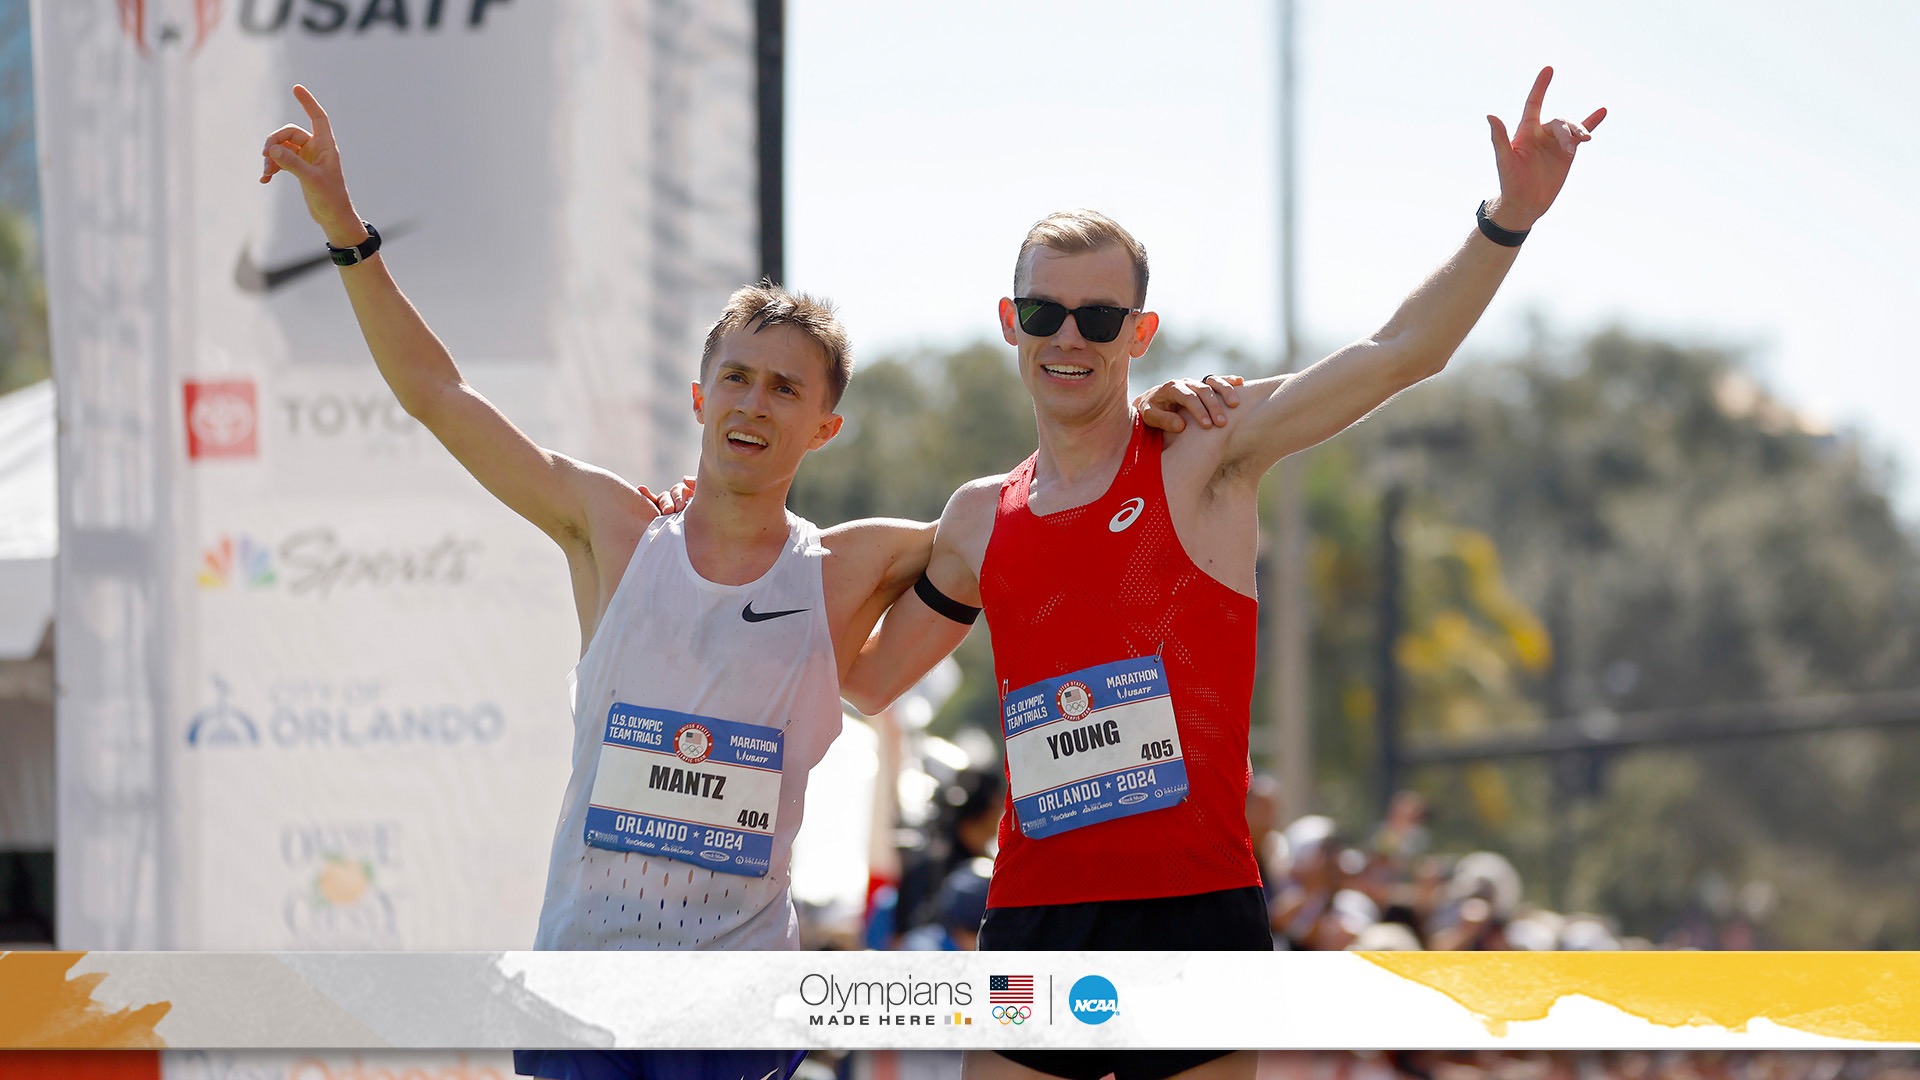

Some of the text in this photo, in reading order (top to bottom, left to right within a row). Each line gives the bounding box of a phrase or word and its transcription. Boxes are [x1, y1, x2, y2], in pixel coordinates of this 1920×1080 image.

[1106, 668, 1158, 689] MARATHON
[1127, 686, 1152, 697] USATF
[1006, 693, 1045, 717] U.S. OLYMPIC
[268, 702, 507, 747] ORLANDO
[611, 713, 664, 732] U.S. OLYMPIC
[1007, 706, 1048, 731] TEAM TRIALS
[609, 726, 663, 746] TEAM TRIALS
[729, 735, 778, 754] MARATHON
[1046, 720, 1121, 760] YOUNG
[745, 753, 769, 764] USATF
[1141, 739, 1174, 762] 405
[648, 764, 727, 801] MANTZ
[1038, 769, 1157, 814] ORLANDO 2024
[736, 809, 770, 830] 404
[615, 814, 688, 842] ORLANDO
[703, 829, 745, 851] 2024
